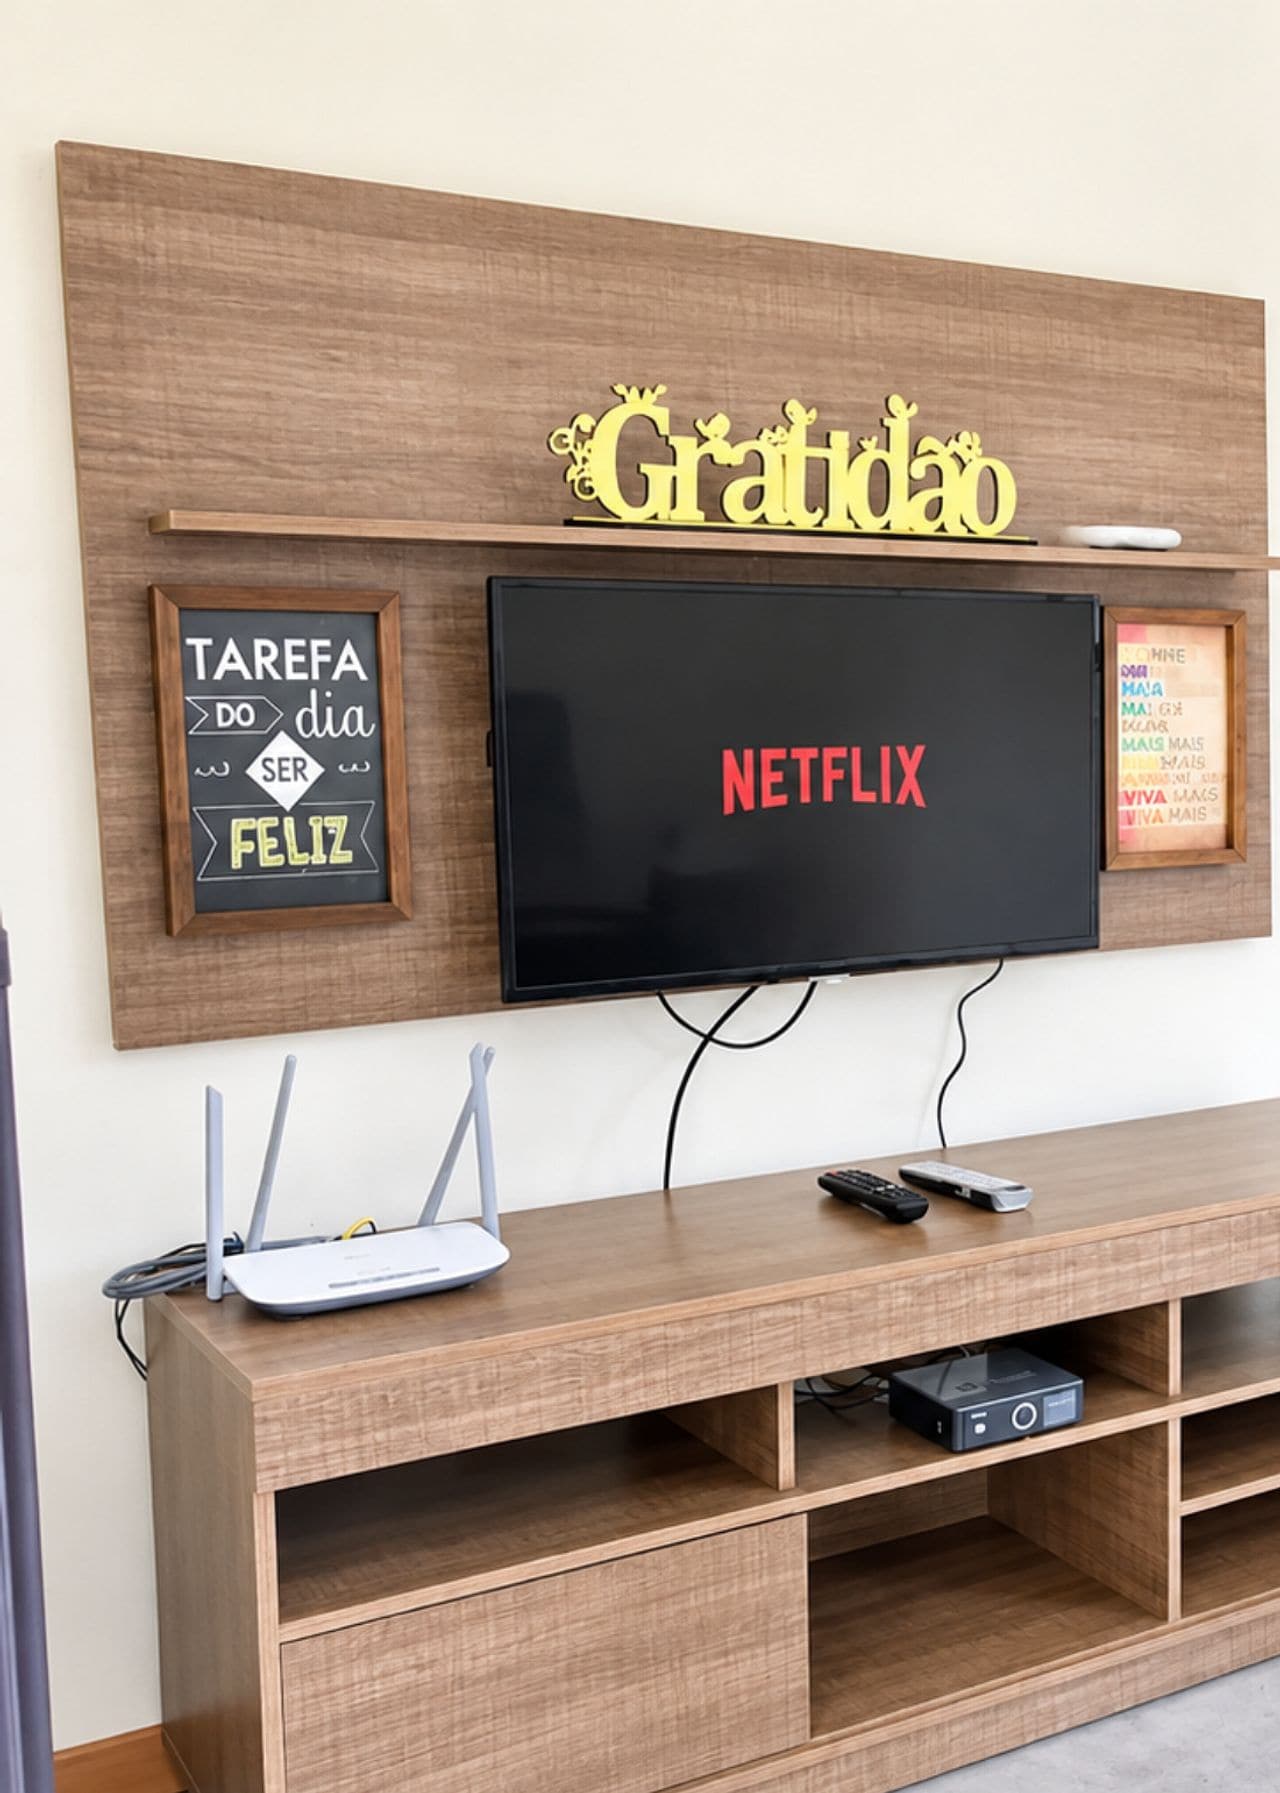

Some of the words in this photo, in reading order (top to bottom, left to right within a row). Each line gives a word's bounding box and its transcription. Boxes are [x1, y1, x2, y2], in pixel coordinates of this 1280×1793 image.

[185, 637, 369, 681] TAREFA
[216, 702, 256, 728] DO
[295, 688, 376, 738] dia
[261, 757, 309, 783] SER
[722, 744, 927, 816] NETFLIX
[1123, 788, 1169, 805] VIVA
[1167, 806, 1208, 824] MAIS
[230, 815, 354, 870] FELIZ
